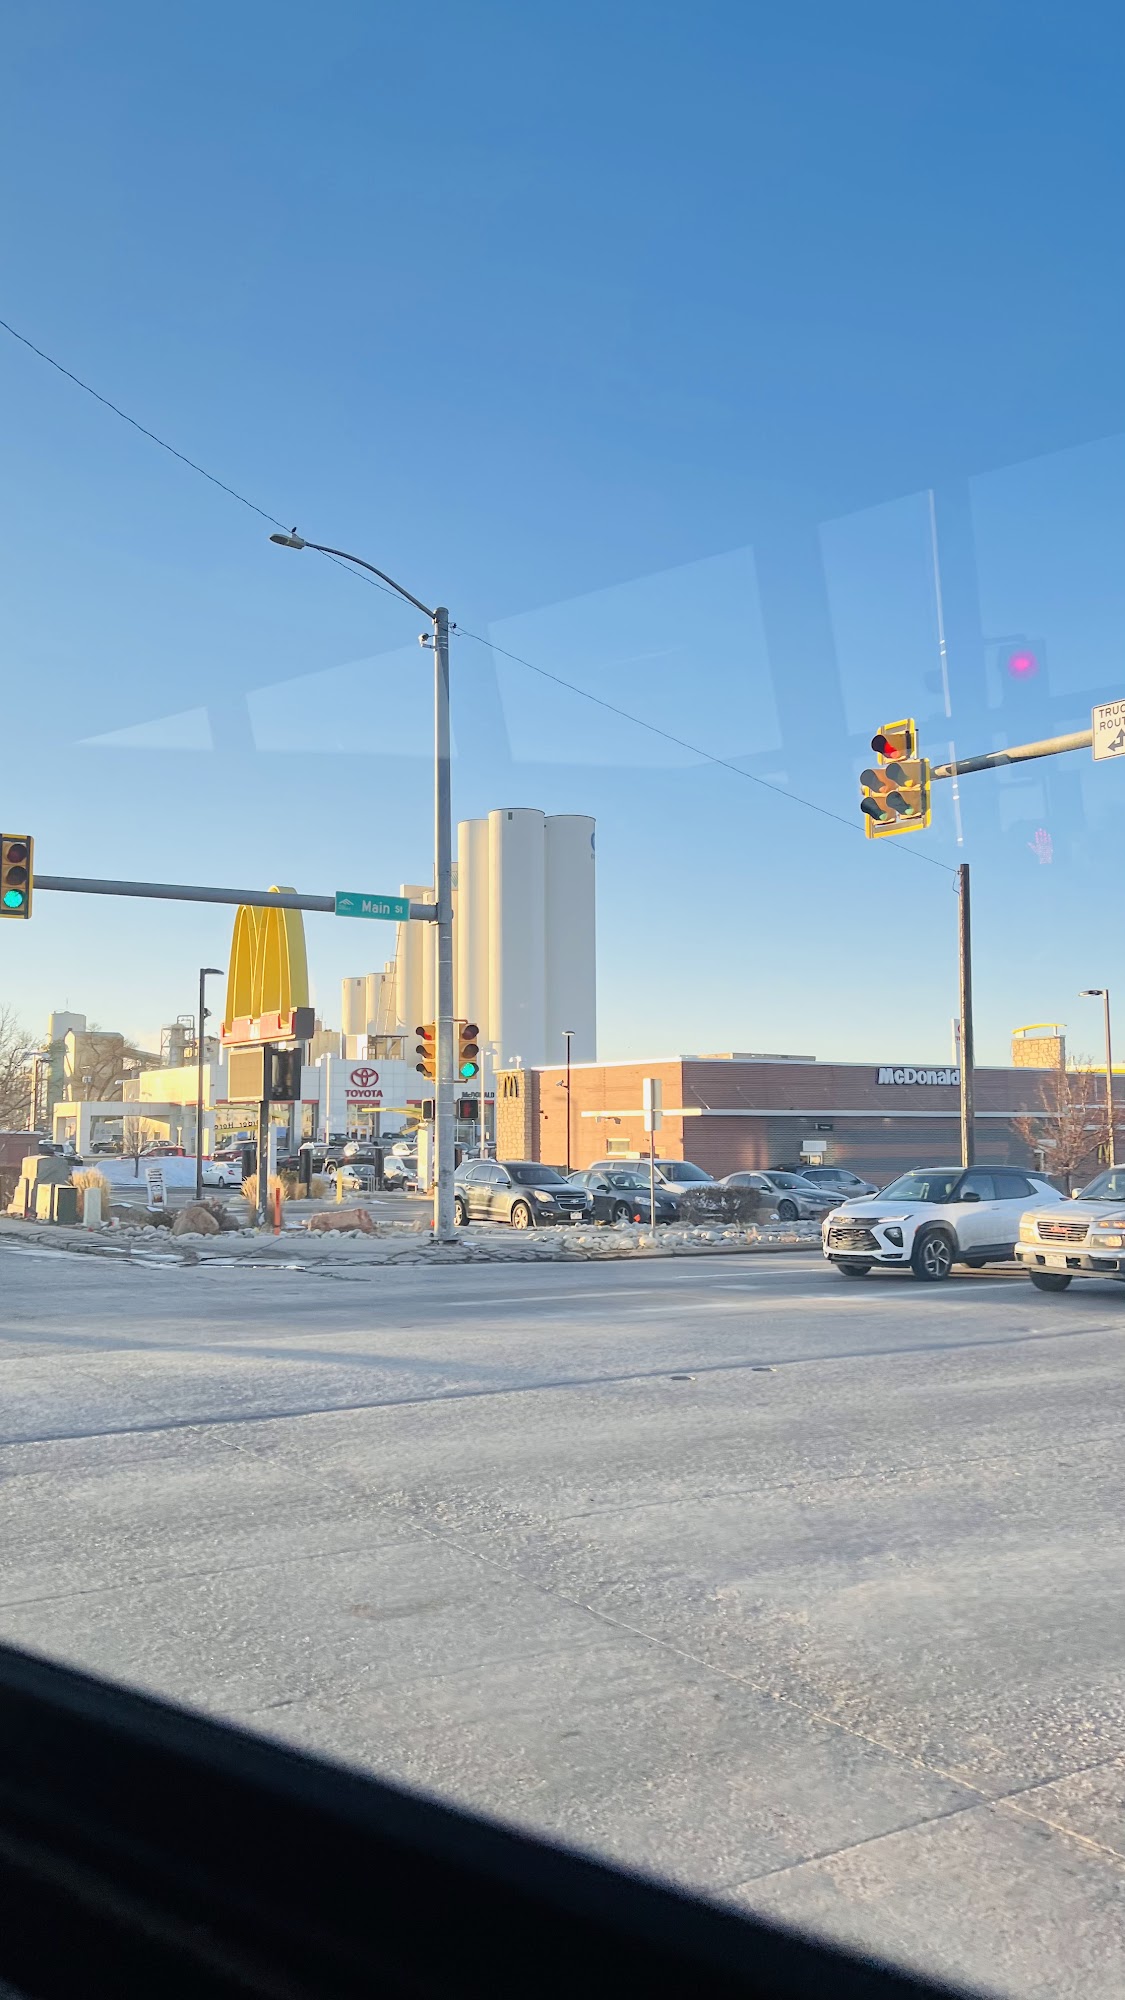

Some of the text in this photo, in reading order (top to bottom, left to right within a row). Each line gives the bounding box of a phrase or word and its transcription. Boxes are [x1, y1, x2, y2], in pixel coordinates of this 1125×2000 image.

[361, 900, 390, 914] Main
[395, 905, 403, 914] St
[345, 1089, 384, 1098] TOYOTA
